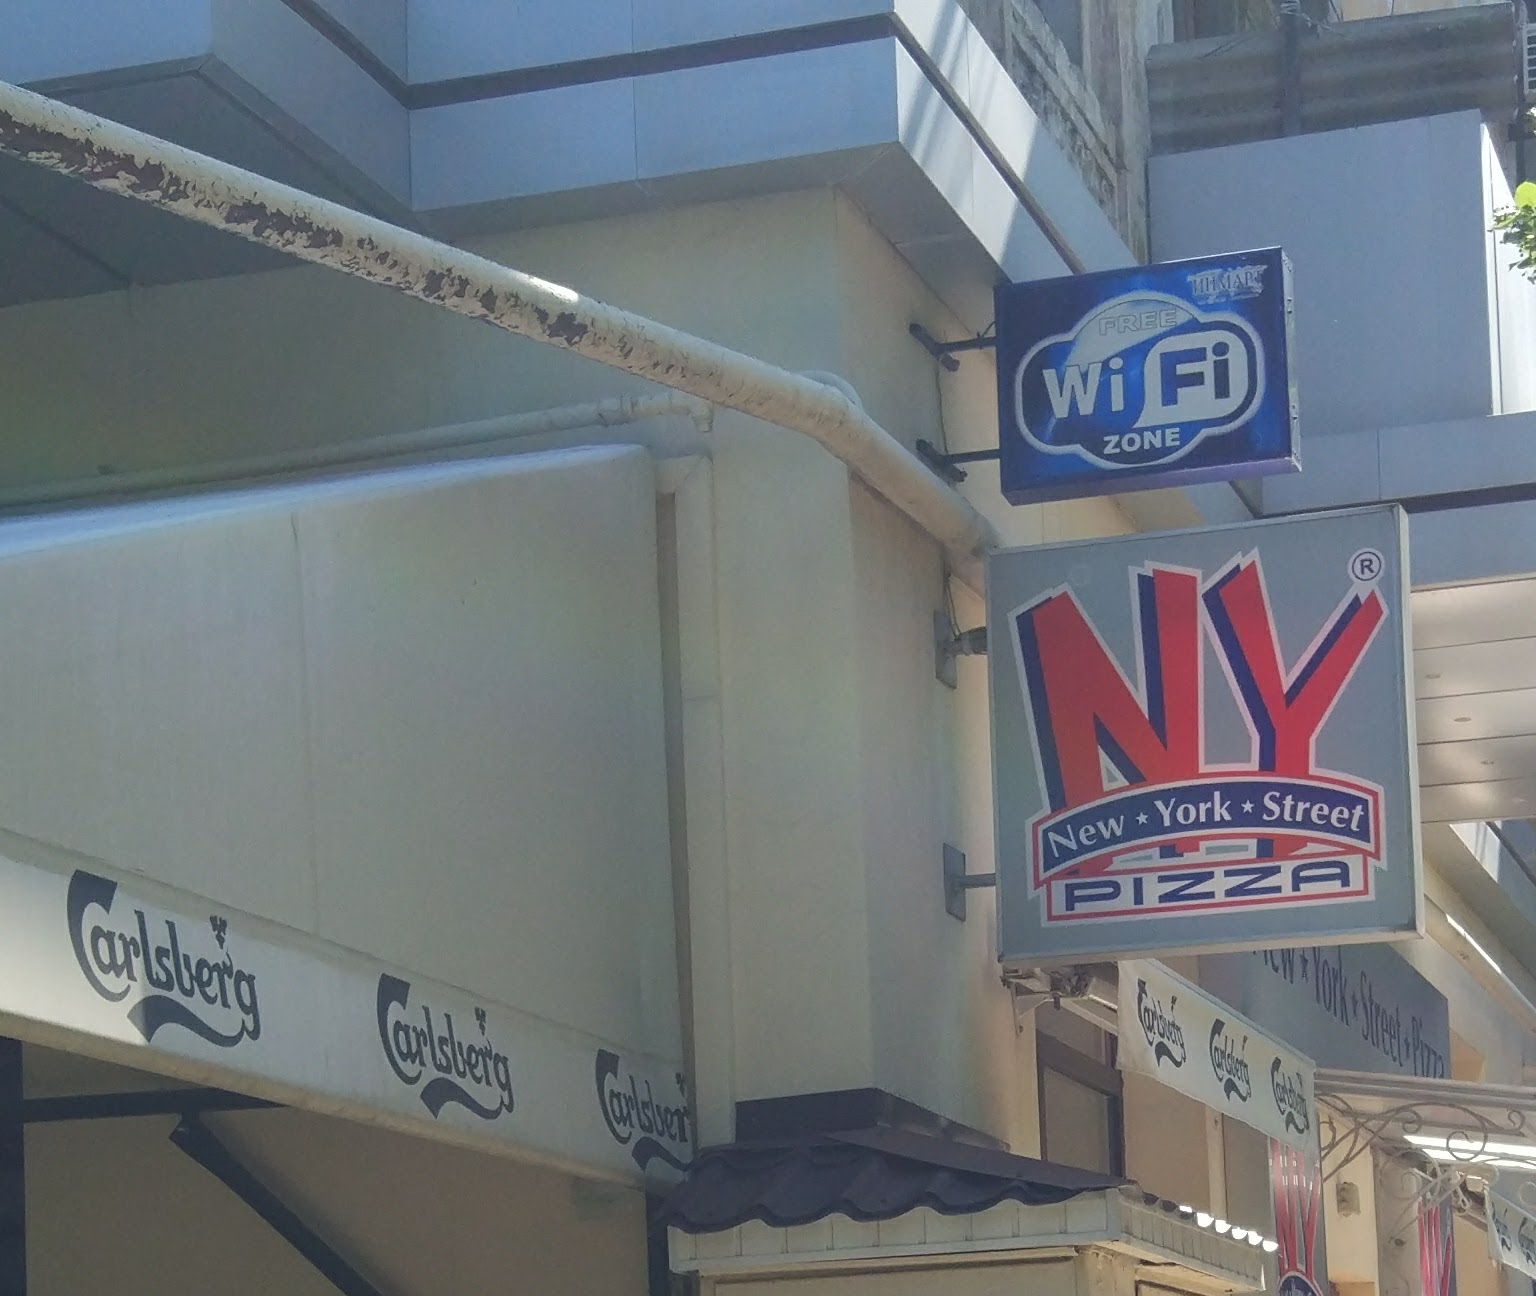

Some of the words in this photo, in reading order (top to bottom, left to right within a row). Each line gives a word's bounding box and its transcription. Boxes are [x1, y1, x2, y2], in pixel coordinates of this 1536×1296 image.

[1098, 308, 1177, 336] FREE
[1102, 428, 1181, 454] ZONE
[1013, 555, 1386, 812] NY
[1047, 814, 1125, 858] New
[1154, 790, 1232, 827] York
[1262, 791, 1365, 832] Street
[1065, 860, 1351, 912] PIZZA
[67, 870, 260, 1047] Carlsberg
[377, 973, 514, 1119] Carlsberg
[1137, 978, 1186, 1068] Carlsberg
[1313, 945, 1350, 1027] York
[1360, 970, 1404, 1067] Street
[1209, 1018, 1252, 1102] Carlsberg
[1270, 1056, 1310, 1134] Carlsberg
[595, 1048, 690, 1172] Carlsber
